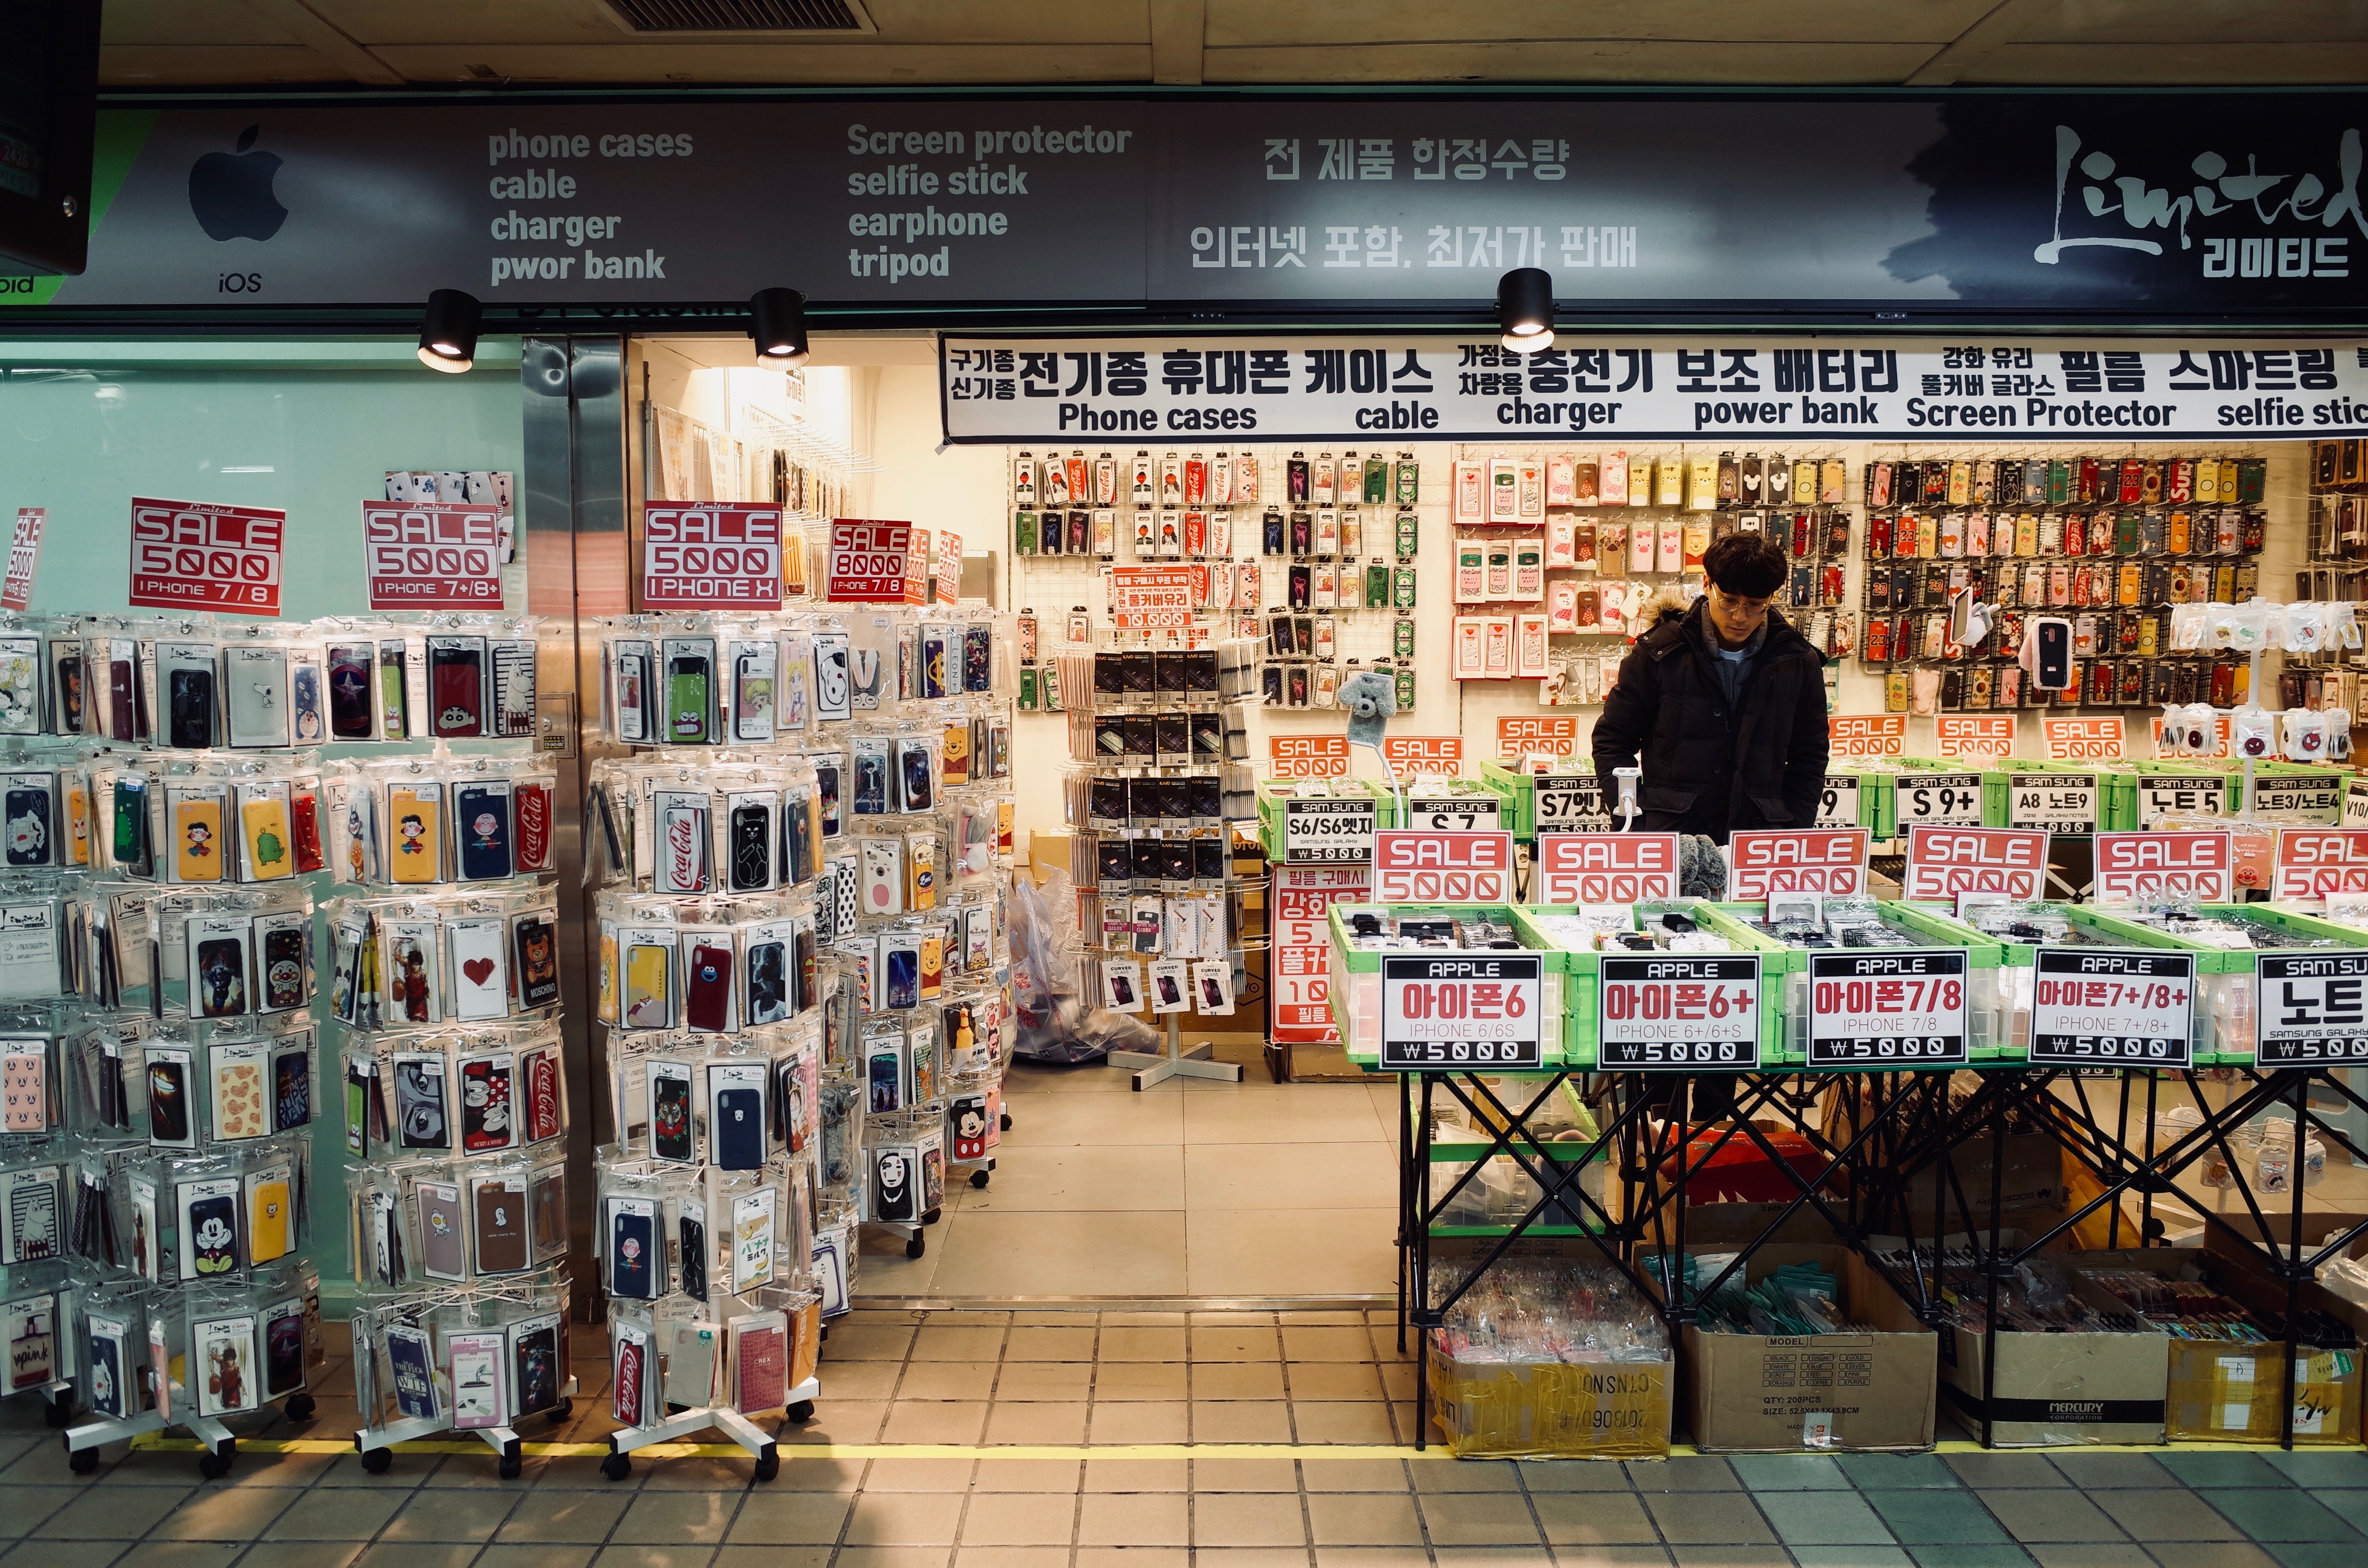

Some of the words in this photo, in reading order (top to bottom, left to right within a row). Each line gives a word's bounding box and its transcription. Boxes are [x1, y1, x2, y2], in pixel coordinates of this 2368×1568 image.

[489, 128, 591, 165] phone
[600, 133, 693, 157] cases
[848, 124, 964, 156] Screen
[975, 126, 1132, 161] protector
[1265, 139, 1300, 180] 전
[1318, 139, 1394, 180] 제품
[1412, 137, 1569, 181] 한정수량
[490, 169, 576, 199] cable
[848, 164, 938, 196] selfie
[948, 164, 1029, 195] stick
[2034, 125, 2368, 264] Limited
[490, 210, 621, 247] charger
[848, 206, 1008, 244] earphone
[1191, 226, 1307, 268] 인터넷
[1324, 226, 1411, 268] 포함,
[1427, 226, 1544, 268] 최저가
[1560, 226, 1636, 268] 판매
[491, 255, 574, 287] pwor
[585, 249, 665, 279] bank
[849, 246, 949, 283] tripod
[219, 273, 262, 294] iOS
[950, 349, 1014, 373] 구기종
[1942, 347, 1986, 368] 강화
[1991, 348, 2033, 368] 유리
[1018, 350, 1148, 397] 전기종
[1161, 348, 1288, 395] 휴대폰
[1305, 348, 1433, 394] 케이스
[1529, 349, 1653, 393] 충전기
[1677, 349, 1760, 393] 보조
[1774, 349, 1899, 393] 배터리
[2060, 351, 2146, 393] 필름
[2168, 349, 2338, 391] 스마트링
[950, 377, 1016, 401] 신기종
[1458, 372, 1522, 396] 차량용
[1922, 374, 1984, 396] 풀커버
[1991, 374, 2056, 397] 글라스
[1058, 403, 1158, 431] Phone
[1167, 405, 1257, 430] cases
[1356, 401, 1439, 430] cable
[1497, 396, 1622, 431] charger
[1695, 398, 1792, 430] power
[1802, 396, 1879, 424] bank
[1906, 398, 2016, 428] Screen
[2026, 398, 2177, 427] Protector
[2217, 398, 2304, 426] selfie
[2123, 475, 2139, 487] 23
[13, 517, 41, 547] SALE
[136, 510, 278, 550] SALE
[369, 512, 493, 544] SALE
[649, 512, 775, 543] SALE
[835, 527, 908, 551] SALE
[1900, 530, 1914, 541] 23
[939, 537, 959, 554] SALE
[9, 551, 33, 576] 5000
[142, 545, 269, 581] 5000
[377, 547, 489, 576] 5000
[654, 547, 769, 574] 5000
[837, 554, 901, 575] 8000
[938, 558, 956, 574] 8000
[444, 580, 497, 596] 7+/8+
[1133, 576, 1154, 585] 구매시
[1172, 576, 1187, 584] 부착
[1129, 594, 1186, 607] 풀커버유리
[1125, 613, 1184, 626] 10.000
[1506, 721, 1569, 736] SALE
[1836, 719, 1898, 736] SALE
[1945, 720, 2007, 736] SALE
[2053, 723, 2116, 739] SALE
[1279, 739, 1343, 756] SALE
[1392, 741, 1456, 758] SALE
[1831, 738, 1901, 757] 5000
[2050, 741, 2120, 759] 5000
[1275, 759, 1344, 776] 5000
[2019, 795, 2040, 808] A8
[1390, 840, 1496, 867] SALE
[1557, 843, 1662, 869] SALE
[1747, 837, 1853, 865] SALE
[1925, 835, 2033, 864] SALE
[2111, 840, 2216, 868] SALE
[1289, 870, 1316, 885] 필름
[1322, 870, 1364, 885] 구매시
[1383, 872, 1500, 900] 5000
[1551, 875, 1668, 903] 5000
[1739, 868, 1857, 898] 5000
[1917, 867, 2035, 898] 5000
[1429, 963, 1500, 977] APPLE
[1648, 964, 1718, 978] APPLE
[1856, 959, 1926, 974] APPLE
[2082, 957, 2152, 973] APPLE
[530, 983, 555, 998] MOSCHINO
[1403, 984, 1526, 1019] 아이폰6
[1606, 984, 1753, 1019] 아이폰6+
[1815, 979, 1961, 1014] 아이폰7/8
[2038, 980, 2188, 1009] 아이폰7+/8+
[2281, 980, 2363, 1026] 노트
[1409, 1024, 1472, 1037] IPHONE
[1479, 1024, 1514, 1039] 6/6S
[1616, 1024, 1679, 1038] IPHONE
[1685, 1024, 1741, 1040] 6+/6+S
[1844, 1018, 1905, 1032] IPHONE
[1912, 1017, 1936, 1031] 7/8
[2055, 1016, 2116, 1032] IPHONE
[2124, 1019, 2170, 1033] 7+/8+
[2269, 1029, 2322, 1039] SAMSUNG
[747, 1250, 766, 1262] ミルク
[2049, 1403, 2104, 1413] MERCURY
